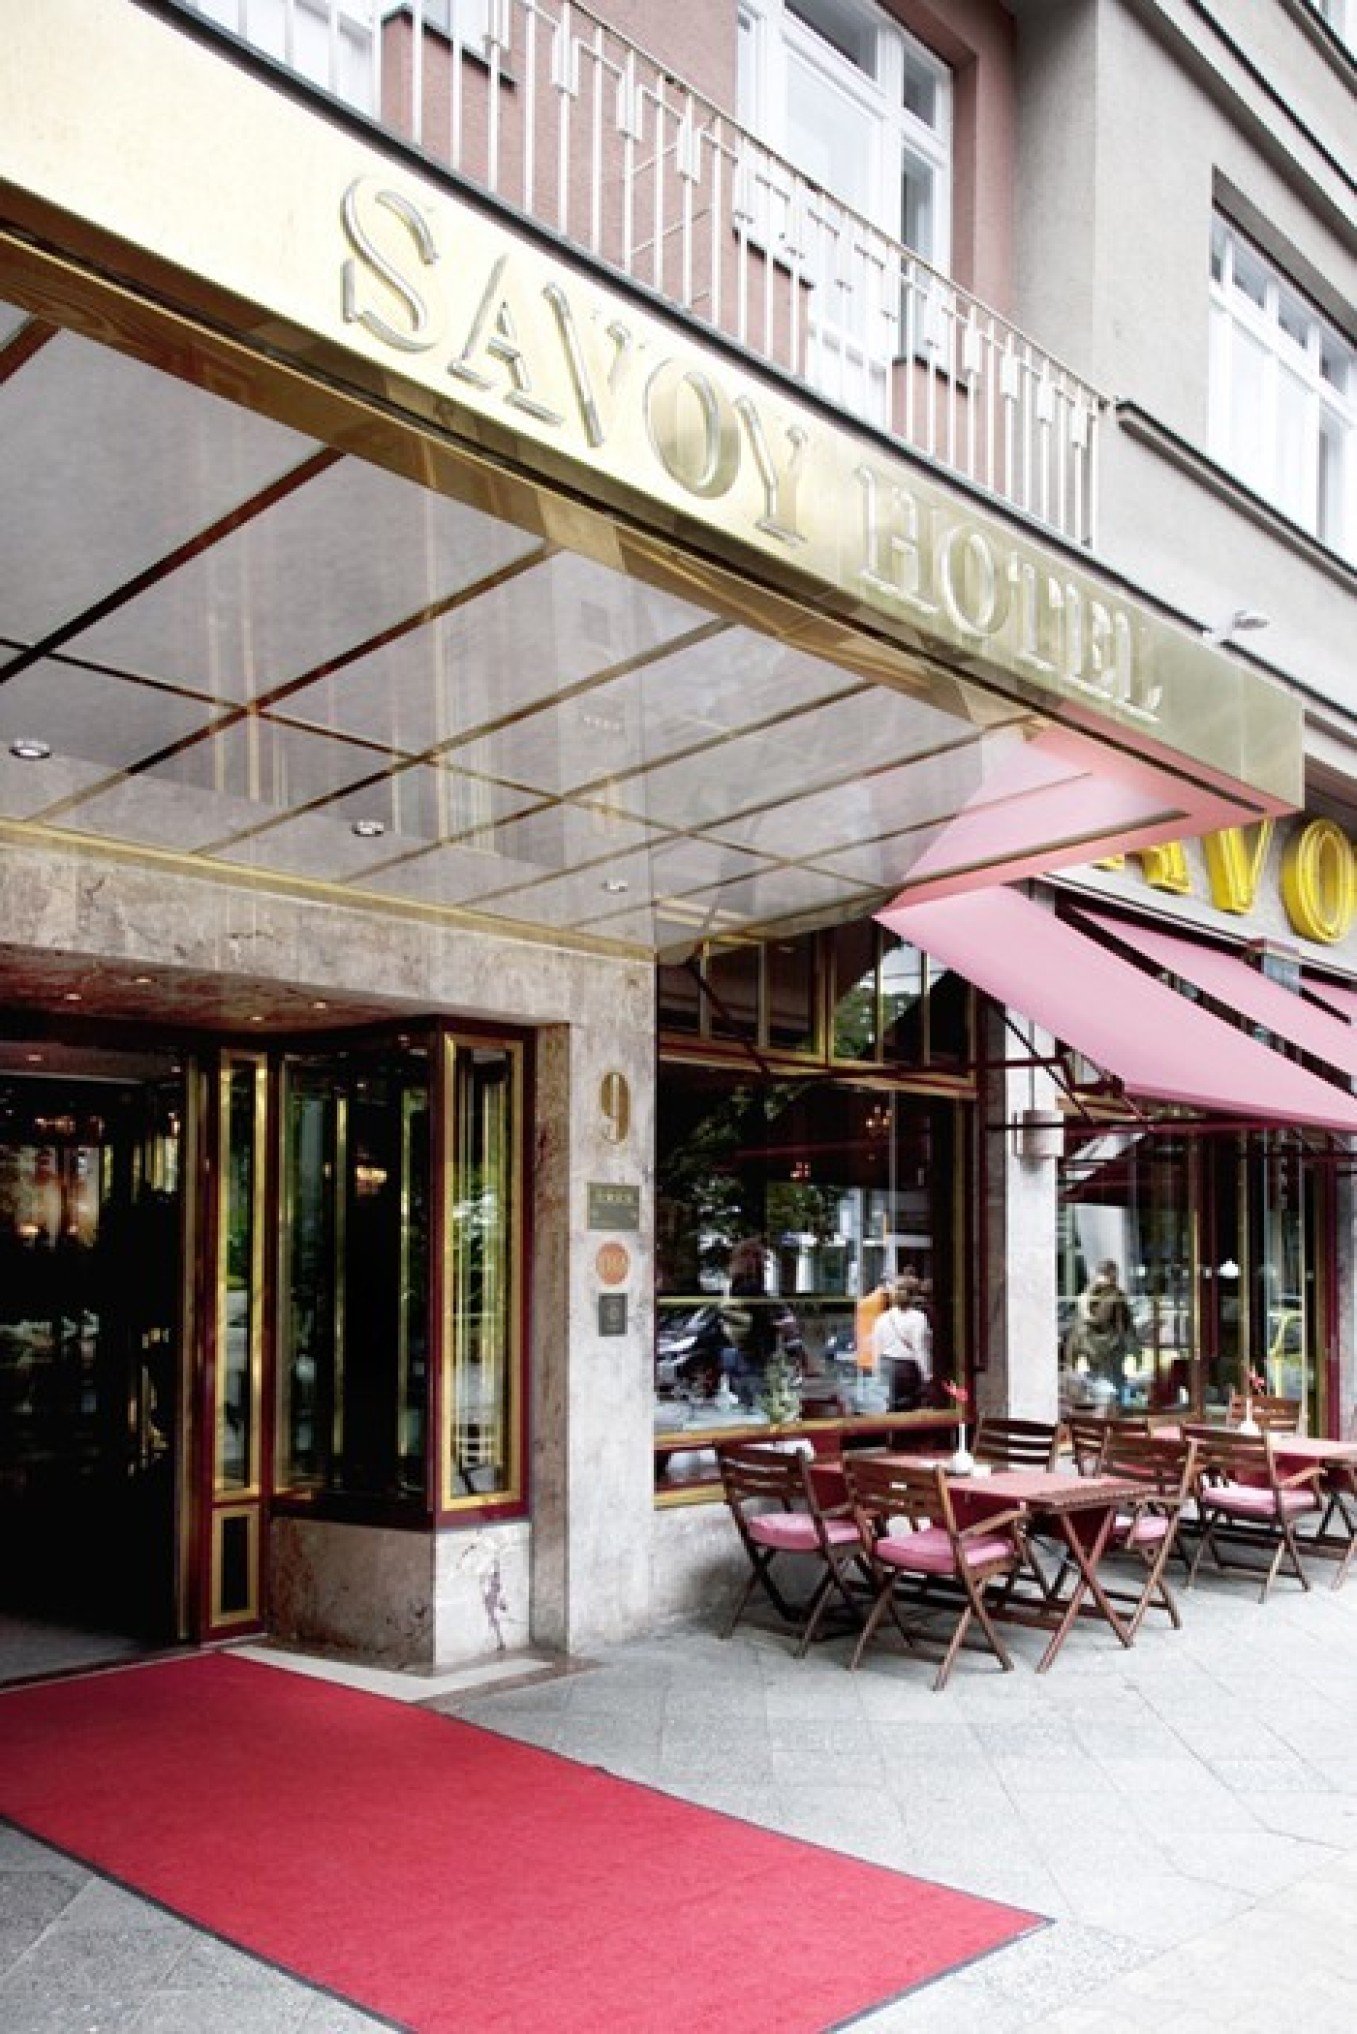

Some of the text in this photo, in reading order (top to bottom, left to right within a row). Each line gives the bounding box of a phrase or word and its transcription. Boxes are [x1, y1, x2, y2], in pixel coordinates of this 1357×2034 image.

[340, 174, 1164, 724] SAVOY HOTEL
[600, 1071, 631, 1145] 9
